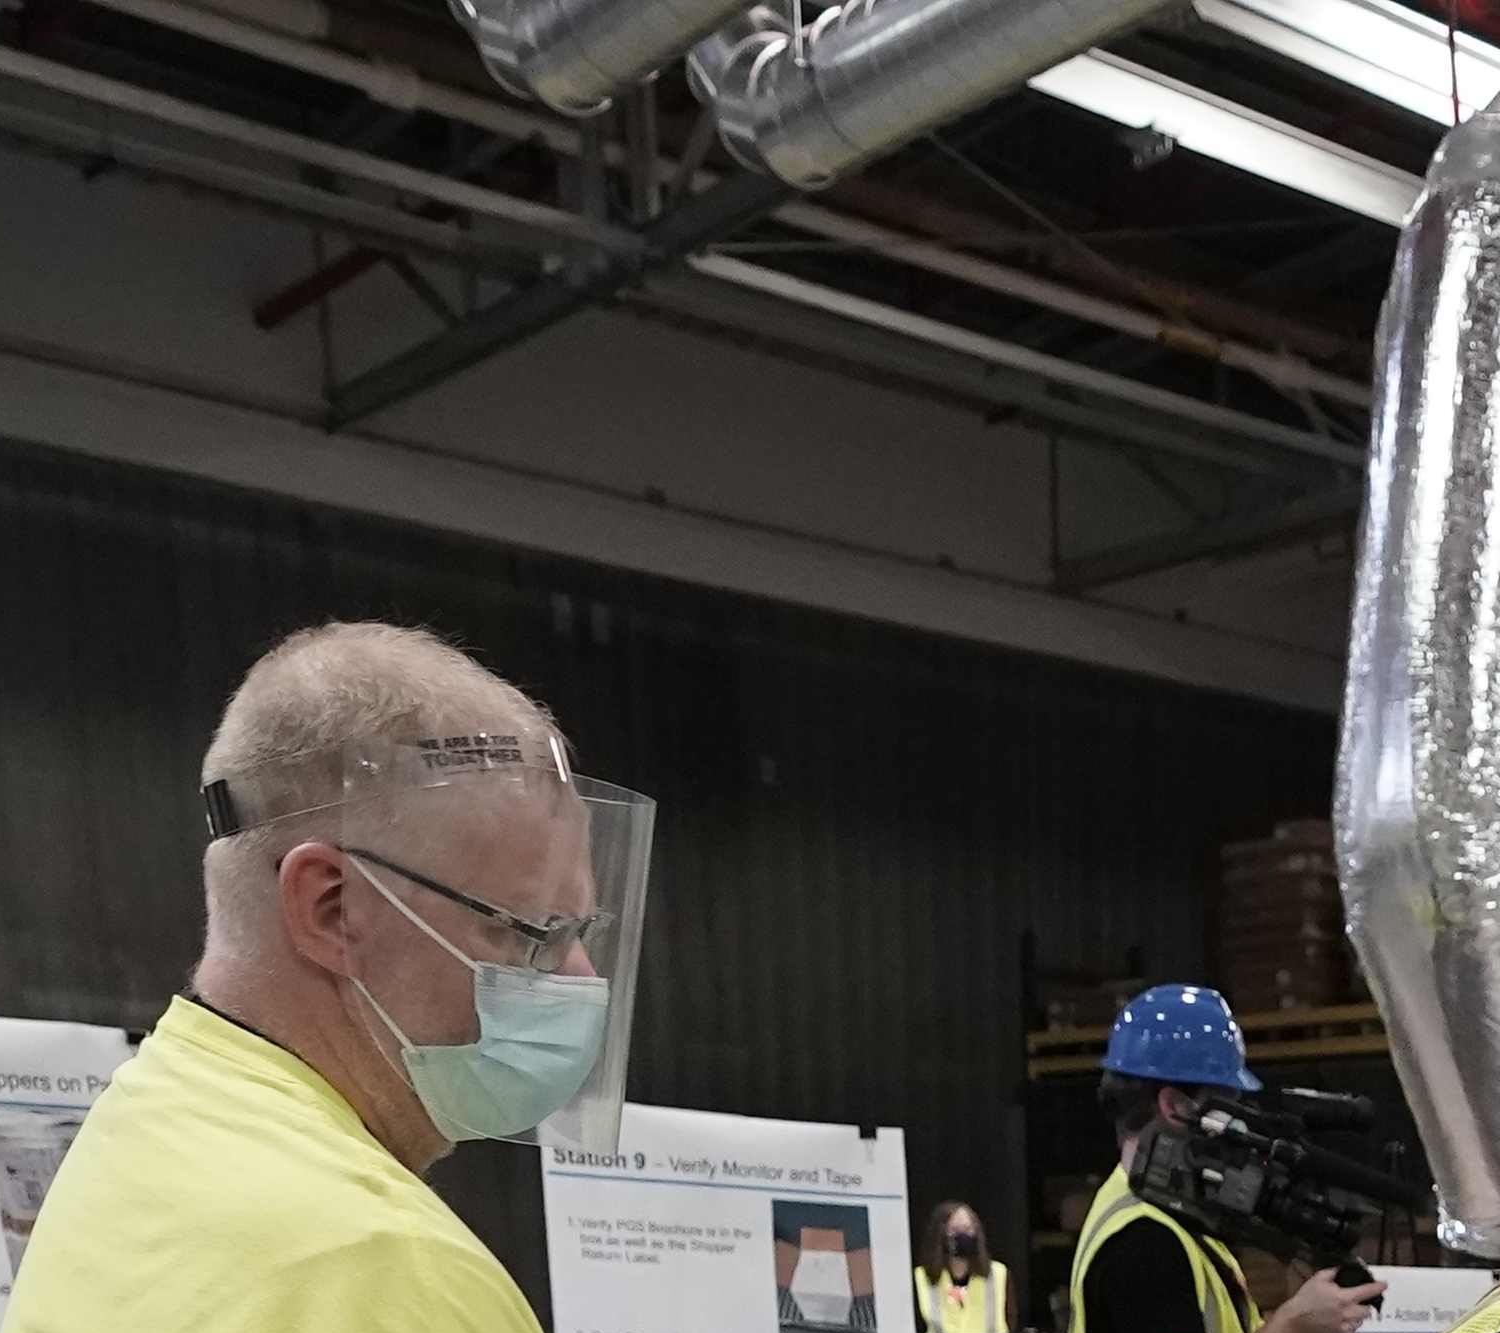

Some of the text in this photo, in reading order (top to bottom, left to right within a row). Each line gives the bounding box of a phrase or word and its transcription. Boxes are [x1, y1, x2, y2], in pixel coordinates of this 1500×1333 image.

[444, 736, 470, 748] ARE
[489, 735, 518, 746] THIS
[420, 748, 524, 769] TOGETHER
[57, 1077, 82, 1093] on
[552, 1147, 863, 1187] Station 9 Verify Monitor and Tape
